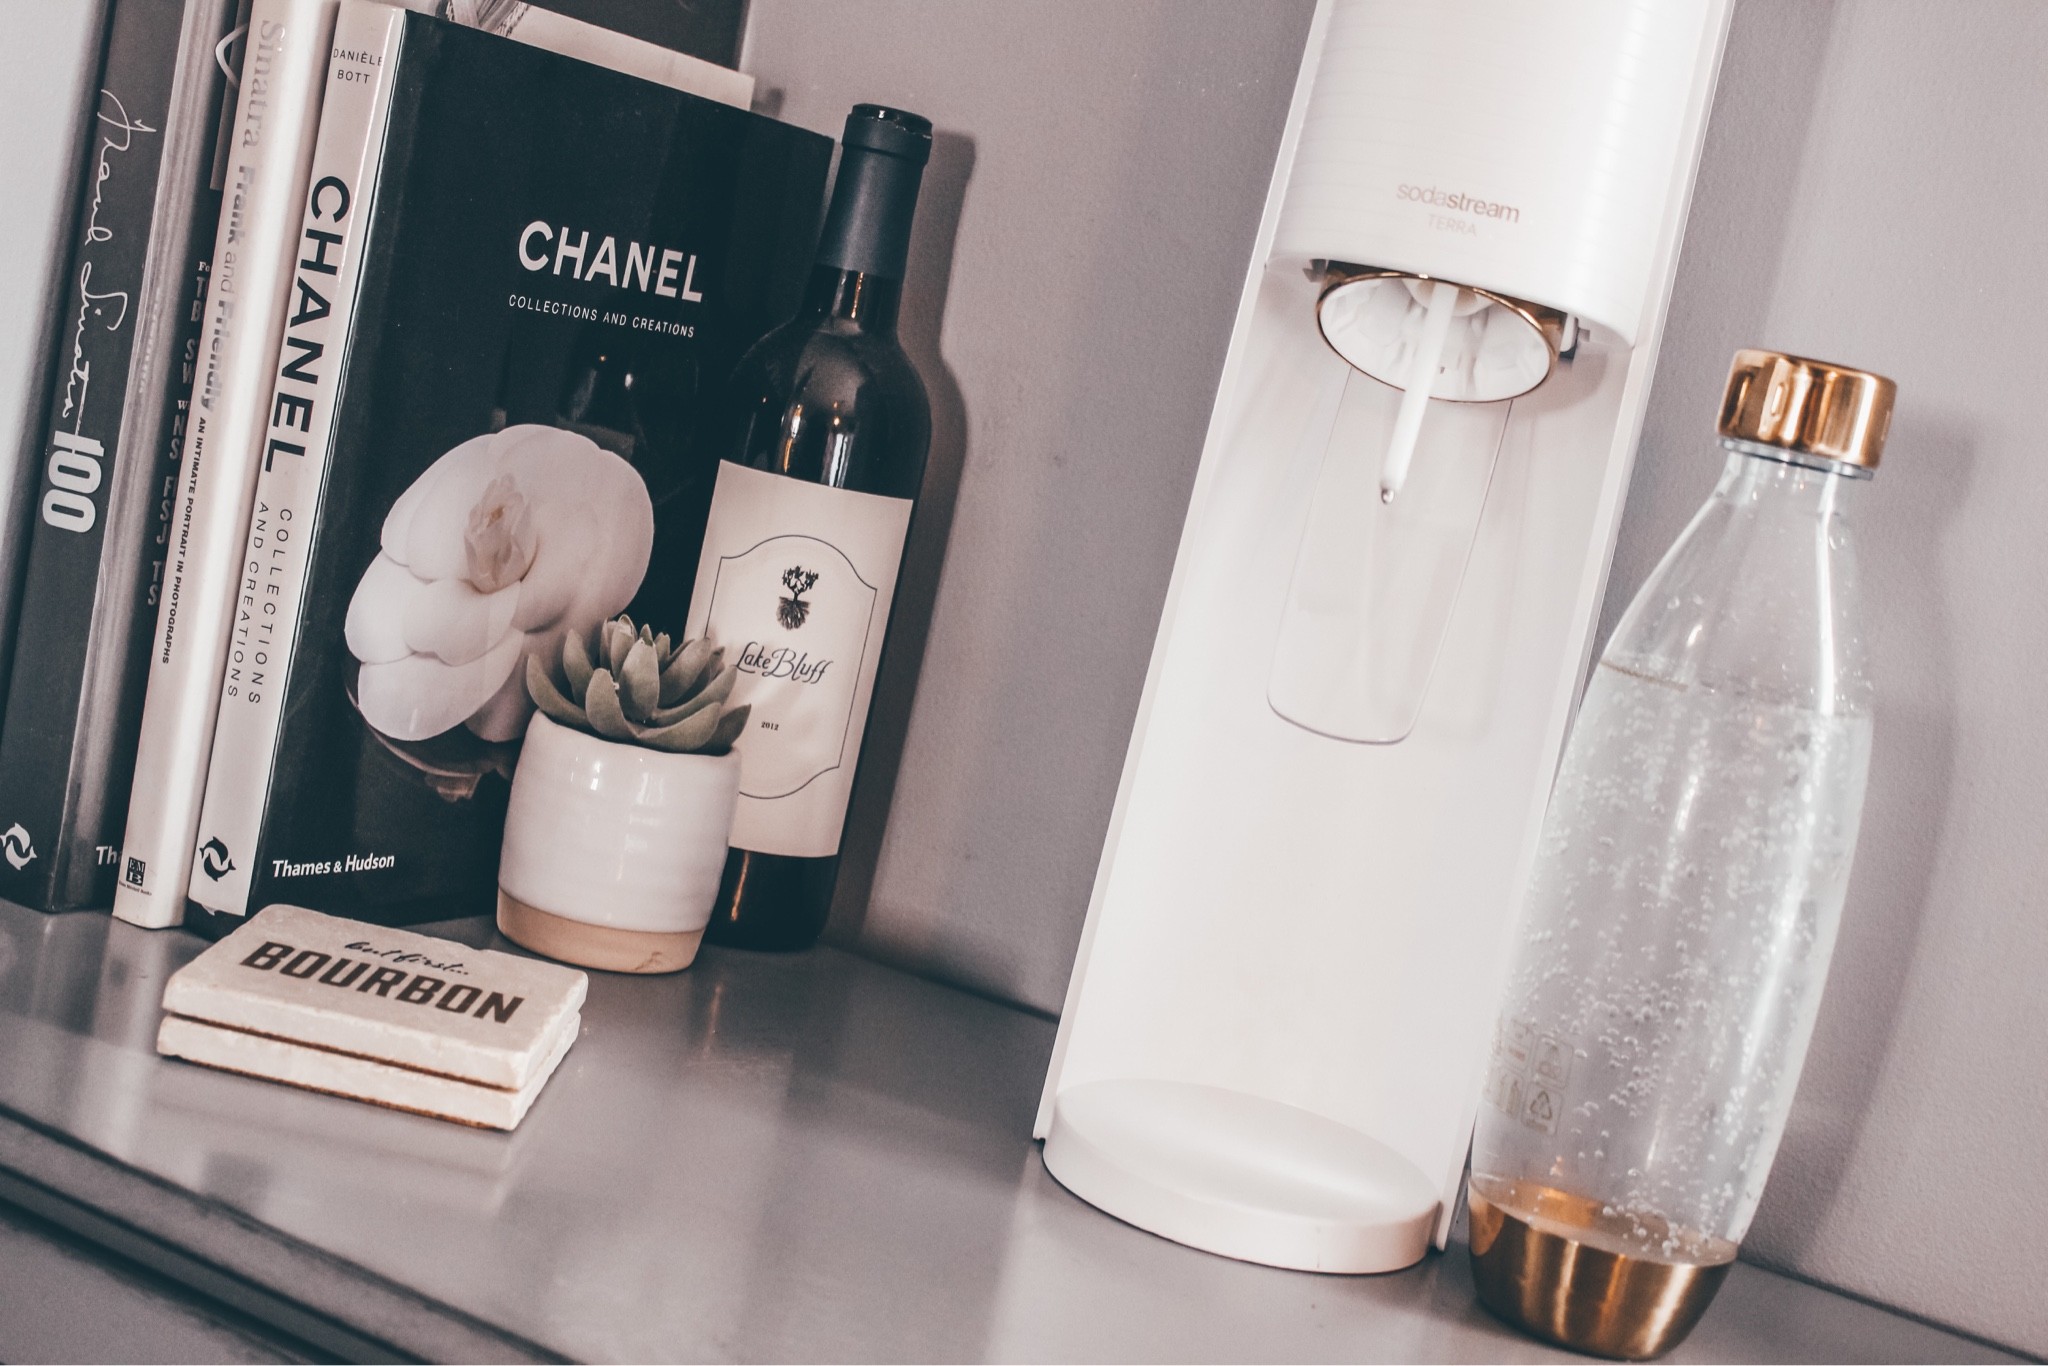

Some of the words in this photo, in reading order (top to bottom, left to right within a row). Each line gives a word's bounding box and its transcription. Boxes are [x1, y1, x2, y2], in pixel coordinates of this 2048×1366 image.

[243, 19, 286, 149] Sinatra
[337, 69, 371, 84] BOTT
[227, 165, 256, 246] Frank
[1396, 181, 1521, 224] sodastream
[1427, 213, 1478, 237] TERRA
[220, 251, 238, 294] and
[518, 220, 703, 303] CHANEL
[264, 175, 351, 473] CHANEL
[508, 294, 598, 321] COLLECTIONS
[603, 312, 627, 326] AND
[632, 316, 695, 338] CREATIONS
[201, 300, 234, 413] Friendly
[197, 416, 207, 434] AN
[42, 429, 105, 533] 100
[188, 437, 204, 494] INTIMATE
[178, 497, 195, 558] PORTRAIT
[253, 501, 269, 549] AND
[175, 560, 184, 573] IN
[162, 576, 182, 665] PHOTOGRAPHS
[227, 561, 259, 697] CREATIONS
[248, 508, 293, 704] COLLECTIONS
[736, 641, 772, 674] Lake
[761, 648, 834, 684] Bluff
[761, 721, 779, 731] 2012
[272, 859, 331, 878] Thames
[333, 861, 342, 873] &
[345, 852, 395, 872] Hudson
[344, 941, 402, 957] but
[240, 940, 526, 1024] BOURBON
